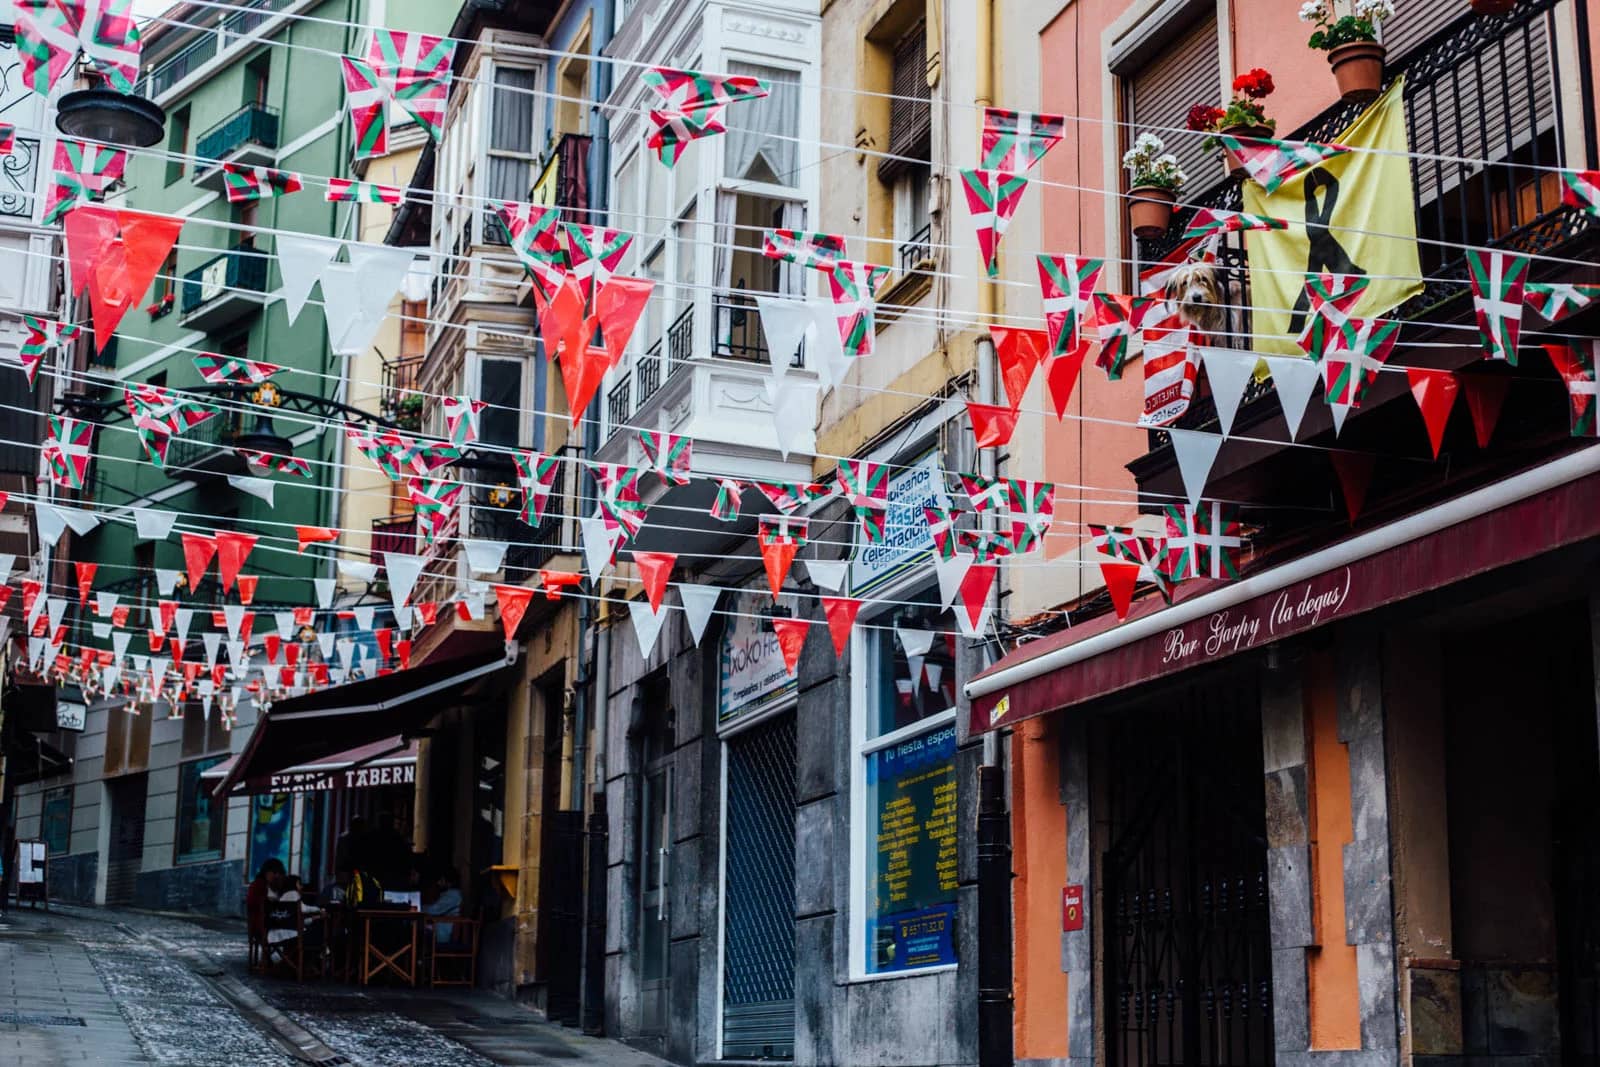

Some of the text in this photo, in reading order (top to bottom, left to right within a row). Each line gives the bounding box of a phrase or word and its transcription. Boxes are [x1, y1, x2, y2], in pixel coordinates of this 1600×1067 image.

[1162, 567, 1351, 664] Bar Garpy (la degus)
[345, 765, 415, 788] TABERN
